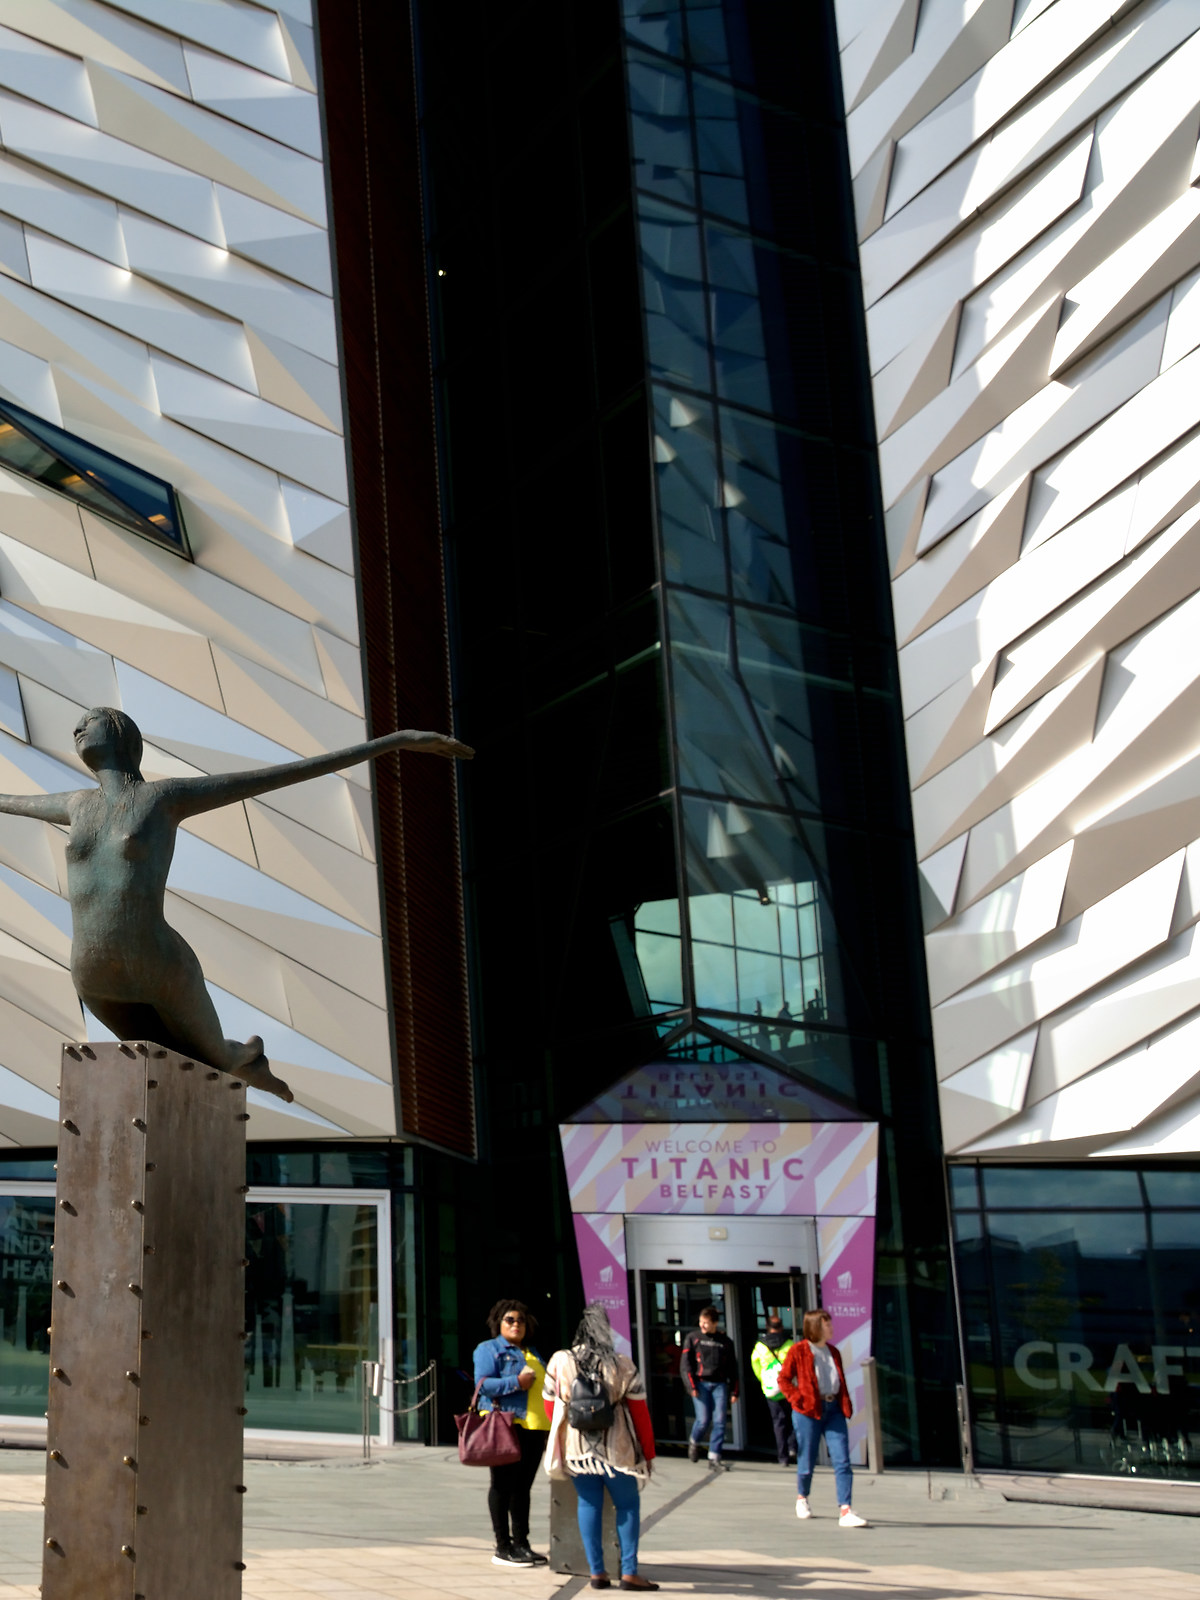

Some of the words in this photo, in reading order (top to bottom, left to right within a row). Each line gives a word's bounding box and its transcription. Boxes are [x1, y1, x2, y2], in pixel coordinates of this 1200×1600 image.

[644, 1140, 743, 1153] WELCOME
[751, 1140, 777, 1153] TO
[621, 1157, 804, 1181] TITANIC
[659, 1184, 767, 1199] BELFAST
[1014, 1340, 1200, 1394] CRAF
